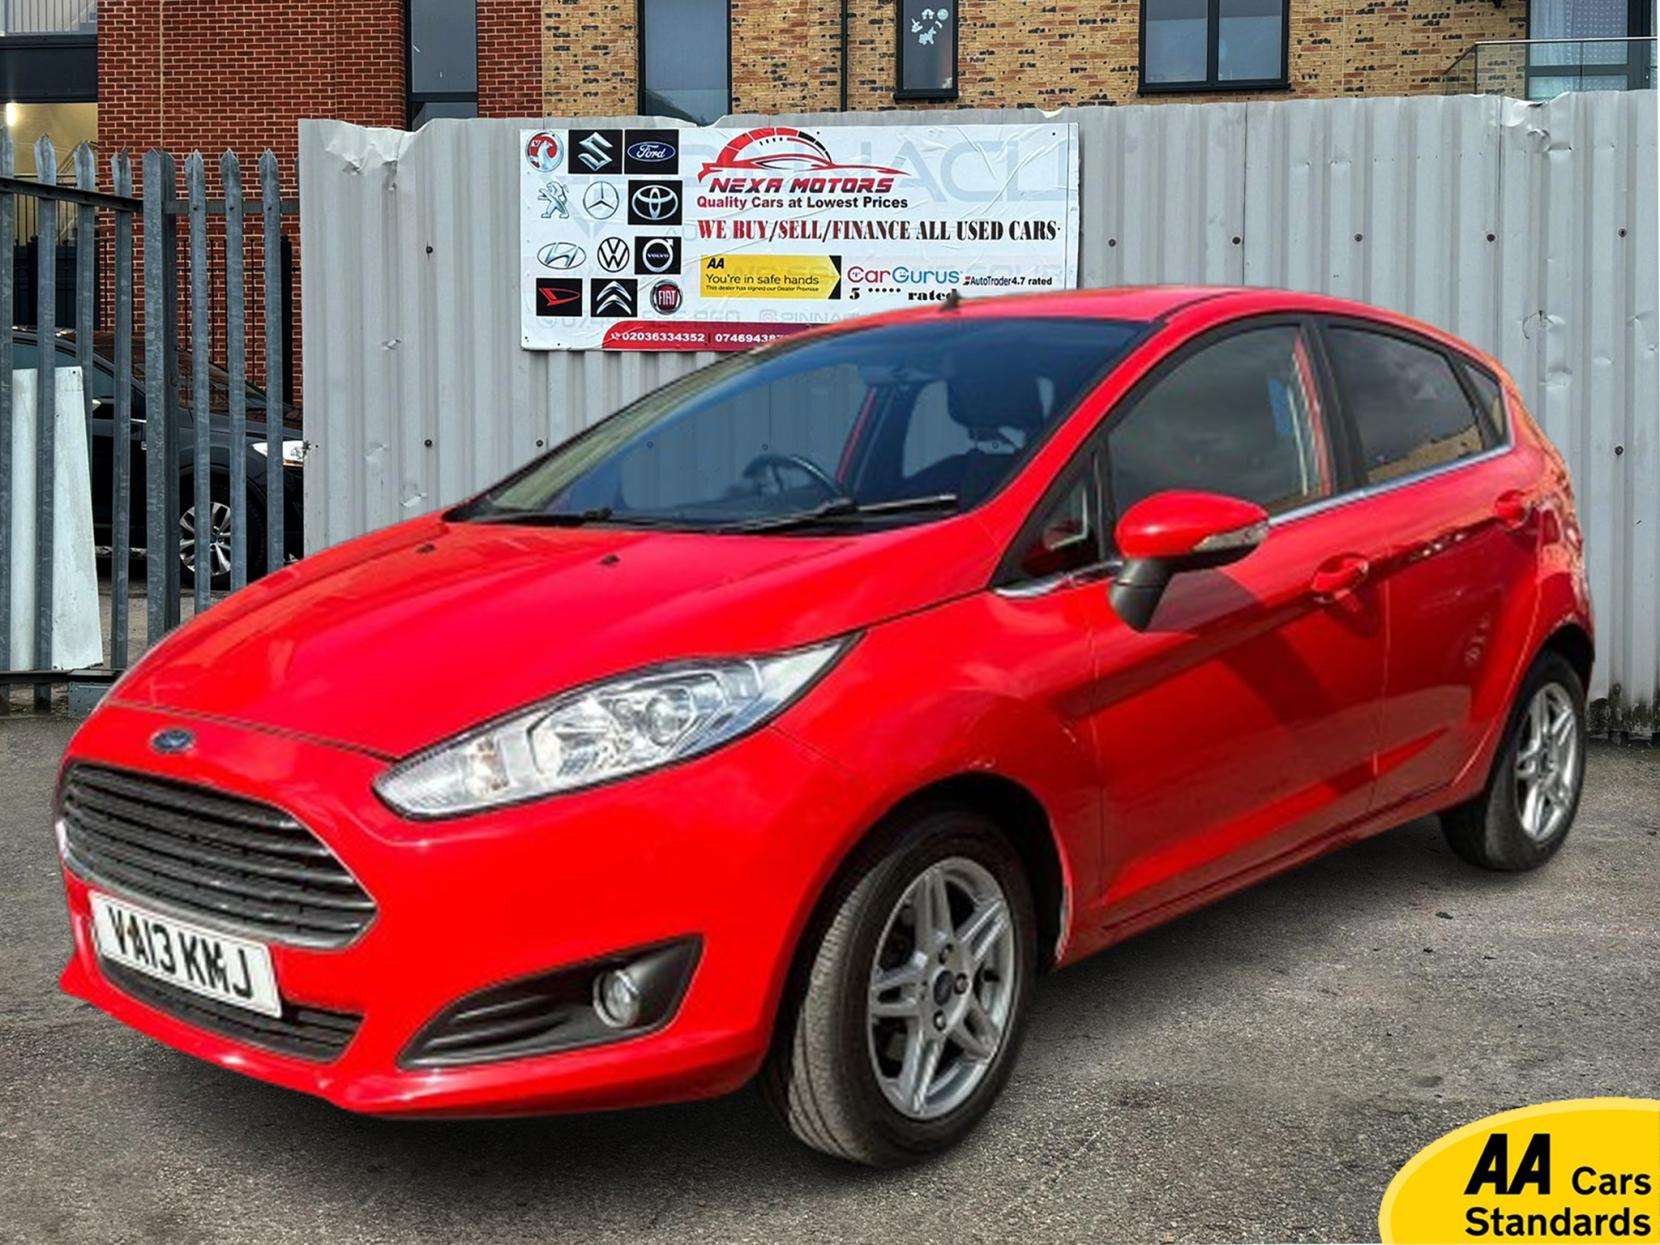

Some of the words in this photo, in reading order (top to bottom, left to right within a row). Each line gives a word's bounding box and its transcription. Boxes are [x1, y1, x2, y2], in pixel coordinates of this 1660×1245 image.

[636, 144, 666, 158] Ford
[709, 178, 784, 193] NEXA
[789, 178, 895, 193] MOTORS
[697, 196, 746, 209] Quality
[752, 196, 784, 208] Cars
[788, 196, 802, 208] at
[807, 196, 858, 208] Lowest
[862, 196, 908, 208] Prices
[697, 220, 727, 239] WE
[916, 220, 951, 240] ALL
[956, 220, 1004, 240] USED
[706, 257, 725, 269] AA
[705, 274, 741, 285] You're
[744, 274, 755, 284] in
[757, 274, 781, 285] safe
[784, 275, 820, 285] hands
[847, 266, 960, 284] CarGurus
[1028, 276, 1053, 285] rated
[658, 290, 676, 305] FIAT
[849, 287, 860, 300] 5
[622, 333, 705, 342] 02036334352
